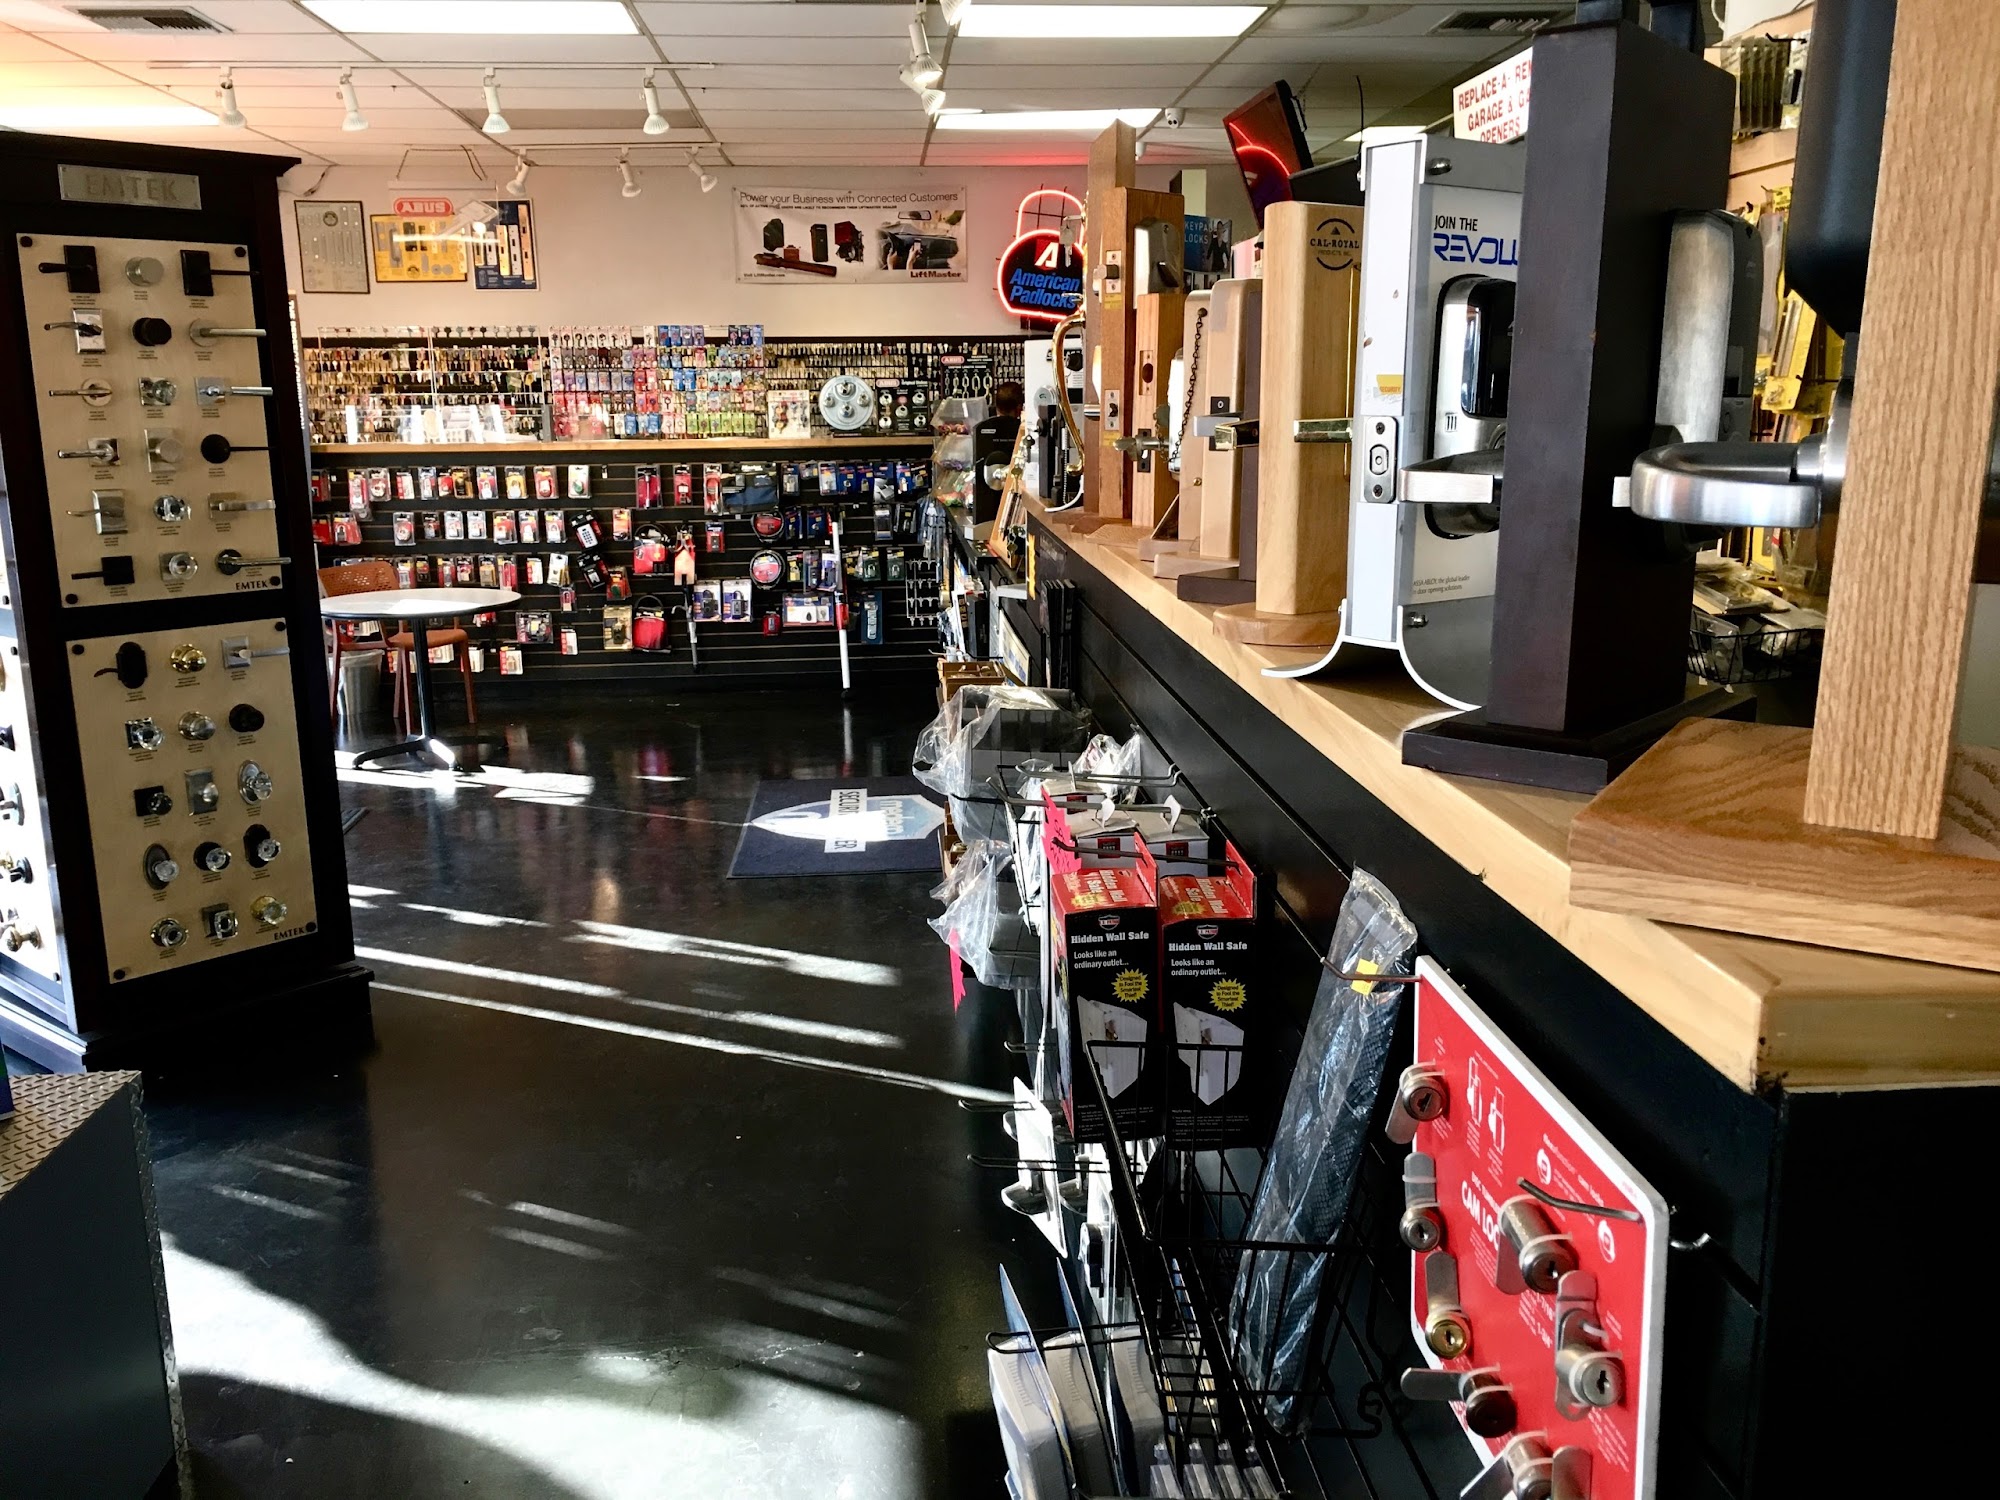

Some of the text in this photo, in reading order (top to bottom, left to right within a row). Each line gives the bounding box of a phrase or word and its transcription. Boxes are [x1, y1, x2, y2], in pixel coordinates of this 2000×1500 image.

[1468, 99, 1503, 131] GARAGE
[1507, 96, 1513, 113] &
[1480, 117, 1520, 143] OPENERS
[87, 174, 177, 200] EMTEK
[740, 192, 958, 204] Power your Business with Connected Customers
[401, 202, 446, 213] ABUS
[1434, 214, 1479, 231] JOIN THE
[1310, 238, 1359, 248] CAL-ROYAL
[910, 270, 962, 278] LiftMaster
[1009, 268, 1081, 292] American
[1010, 285, 1078, 309] Padlocks
[235, 580, 268, 590] EMTEK
[1185, 888, 1204, 901] Safe
[274, 927, 305, 940] EMTEK
[1071, 931, 1150, 944] Hidden Wall Safe
[1168, 941, 1248, 952] Hidden Wall Safe
[1074, 950, 1094, 959] Looks
[1094, 949, 1107, 958] like
[1074, 960, 1102, 969] ordinary
[1171, 958, 1191, 967] Looks
[1192, 958, 1205, 966] like
[1171, 969, 1199, 977] ordinary
[1461, 1180, 1481, 1226] CAM
